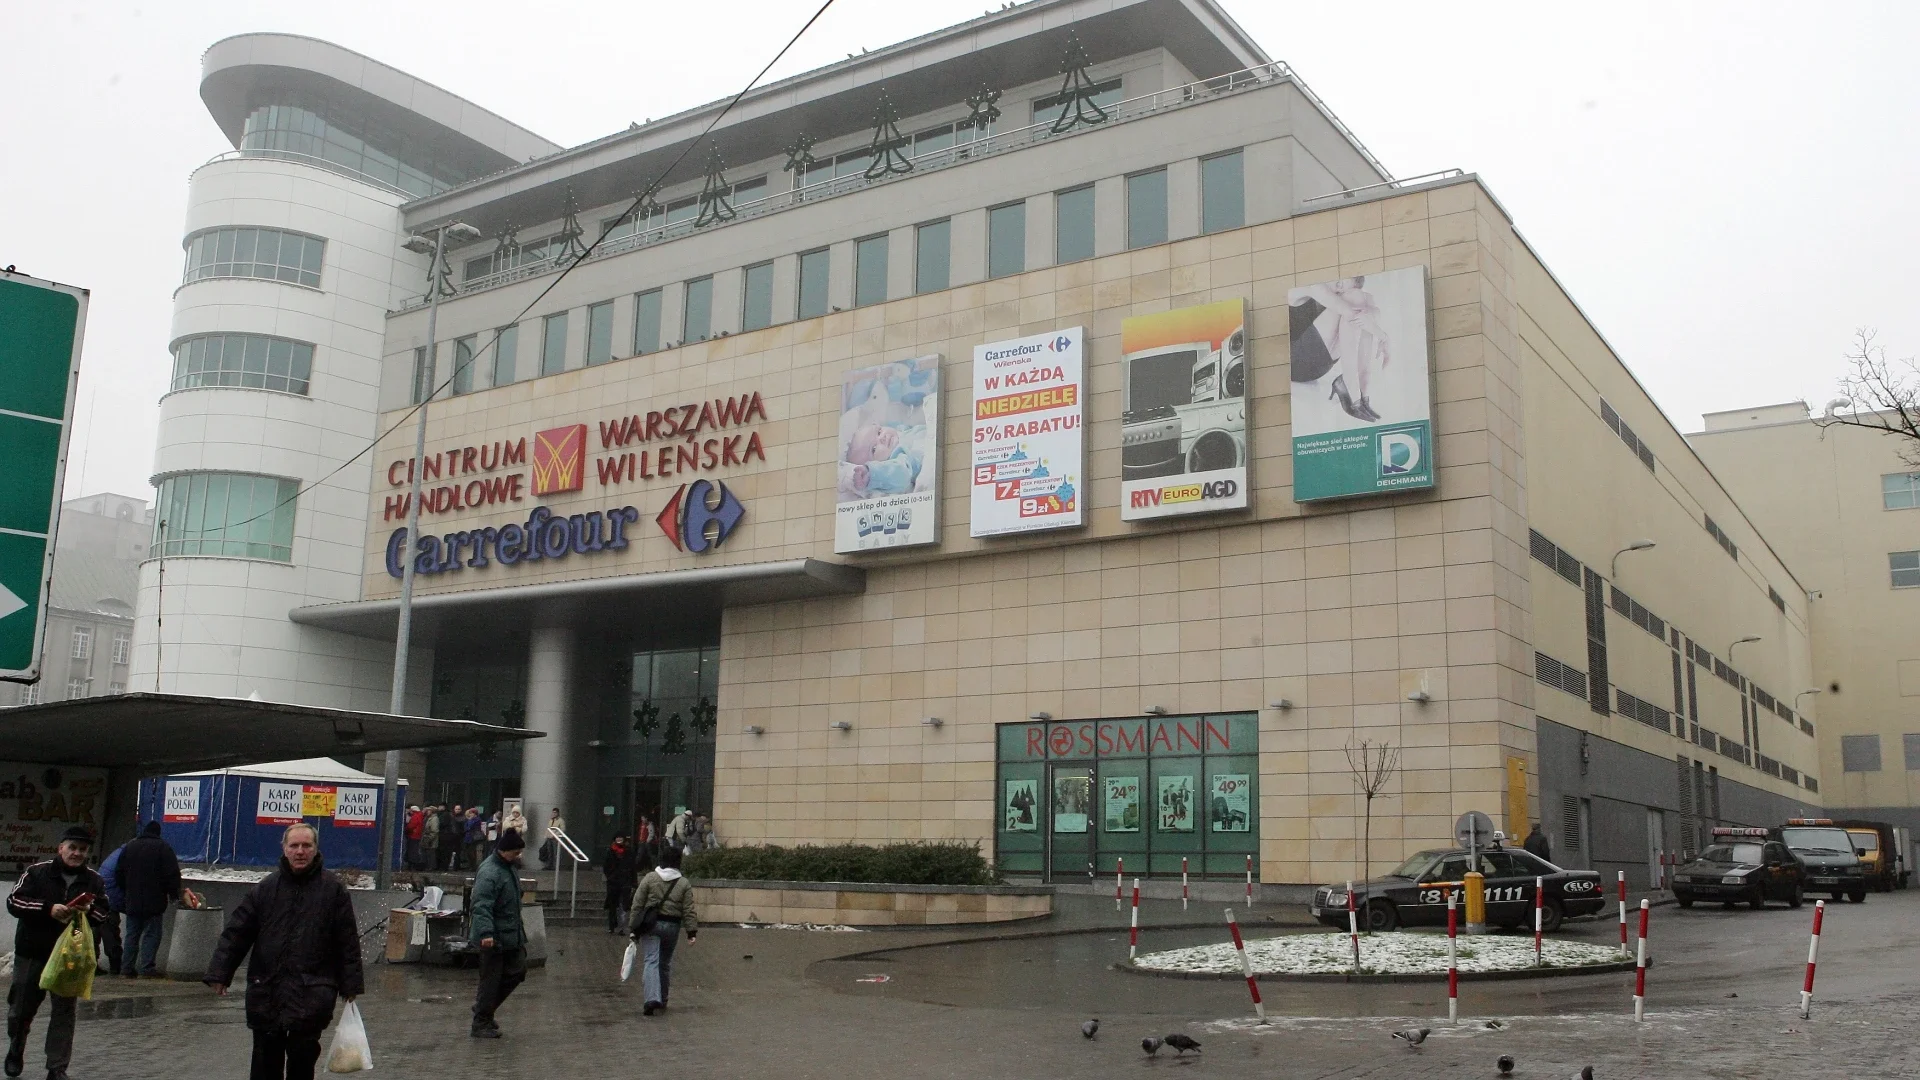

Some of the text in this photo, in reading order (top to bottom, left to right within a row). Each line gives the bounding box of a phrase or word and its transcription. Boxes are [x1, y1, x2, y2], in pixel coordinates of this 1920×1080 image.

[985, 343, 1043, 361] Carrefour
[984, 365, 1065, 391] W KAŻDĄ
[978, 387, 1074, 417] NIEDZIELĘ
[599, 391, 767, 448] WARSZAWA
[974, 414, 1081, 443] 5% RABATU!
[1296, 440, 1330, 449] Największa
[1344, 434, 1369, 442] sklepów
[597, 431, 766, 486] WILEŃSKA
[1376, 475, 1428, 487] DEICHMANN
[1130, 480, 1237, 508] RTV EURO AGD
[838, 505, 855, 513] nowy
[856, 502, 874, 510] sklep
[876, 500, 887, 508] dla
[889, 496, 910, 506] dzieci
[858, 509, 910, 529] smyk
[385, 505, 640, 579] Carrefour
[1026, 719, 1230, 756] ROSSMANN
[172, 786, 194, 797] KARP
[268, 788, 297, 800] KARP
[1110, 786, 1127, 800] 24
[1218, 780, 1236, 794] 49
[167, 798, 196, 810] POLSKI
[344, 792, 370, 804] KARP
[18, 791, 95, 823] BAR
[262, 800, 300, 814] POLSKI
[338, 804, 373, 816] POLSKI
[1162, 814, 1176, 828] 12
